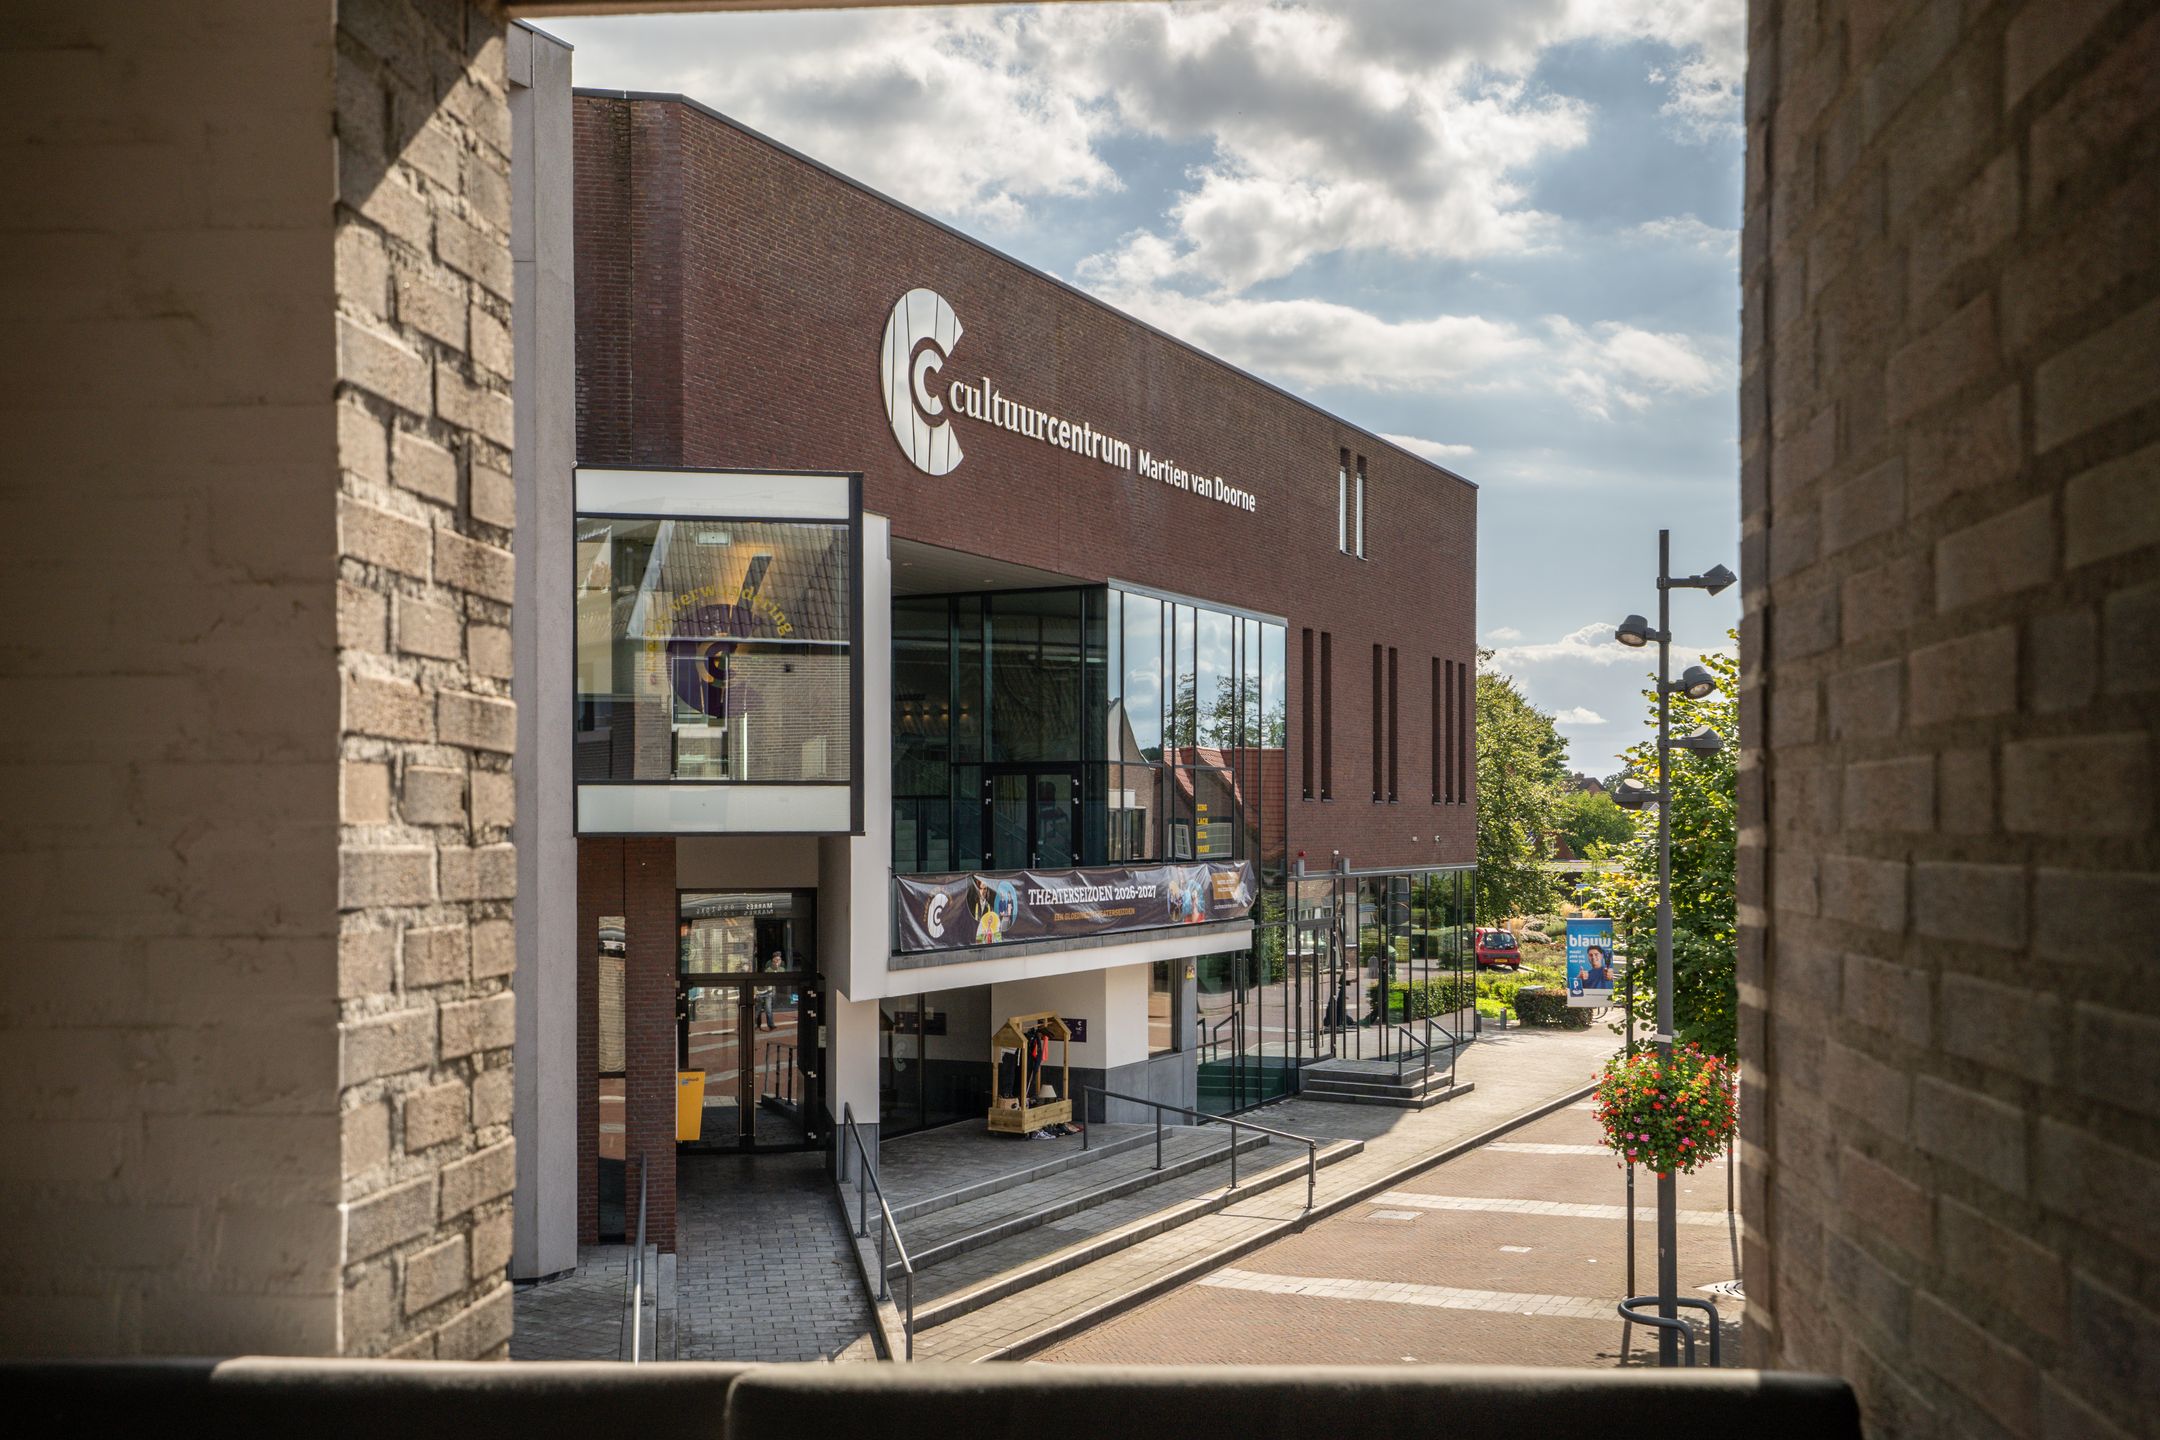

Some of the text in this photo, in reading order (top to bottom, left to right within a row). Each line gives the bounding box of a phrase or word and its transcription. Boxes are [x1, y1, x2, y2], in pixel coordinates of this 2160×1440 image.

[949, 375, 1257, 513] cultuurcentrum Martien van Doorne
[670, 584, 794, 637] verwdering
[1028, 884, 1157, 906] THEATERSEIZOEN 2026-2027
[1093, 907, 1136, 918] EATERSEIZOEN
[1569, 934, 1611, 947] blauw
